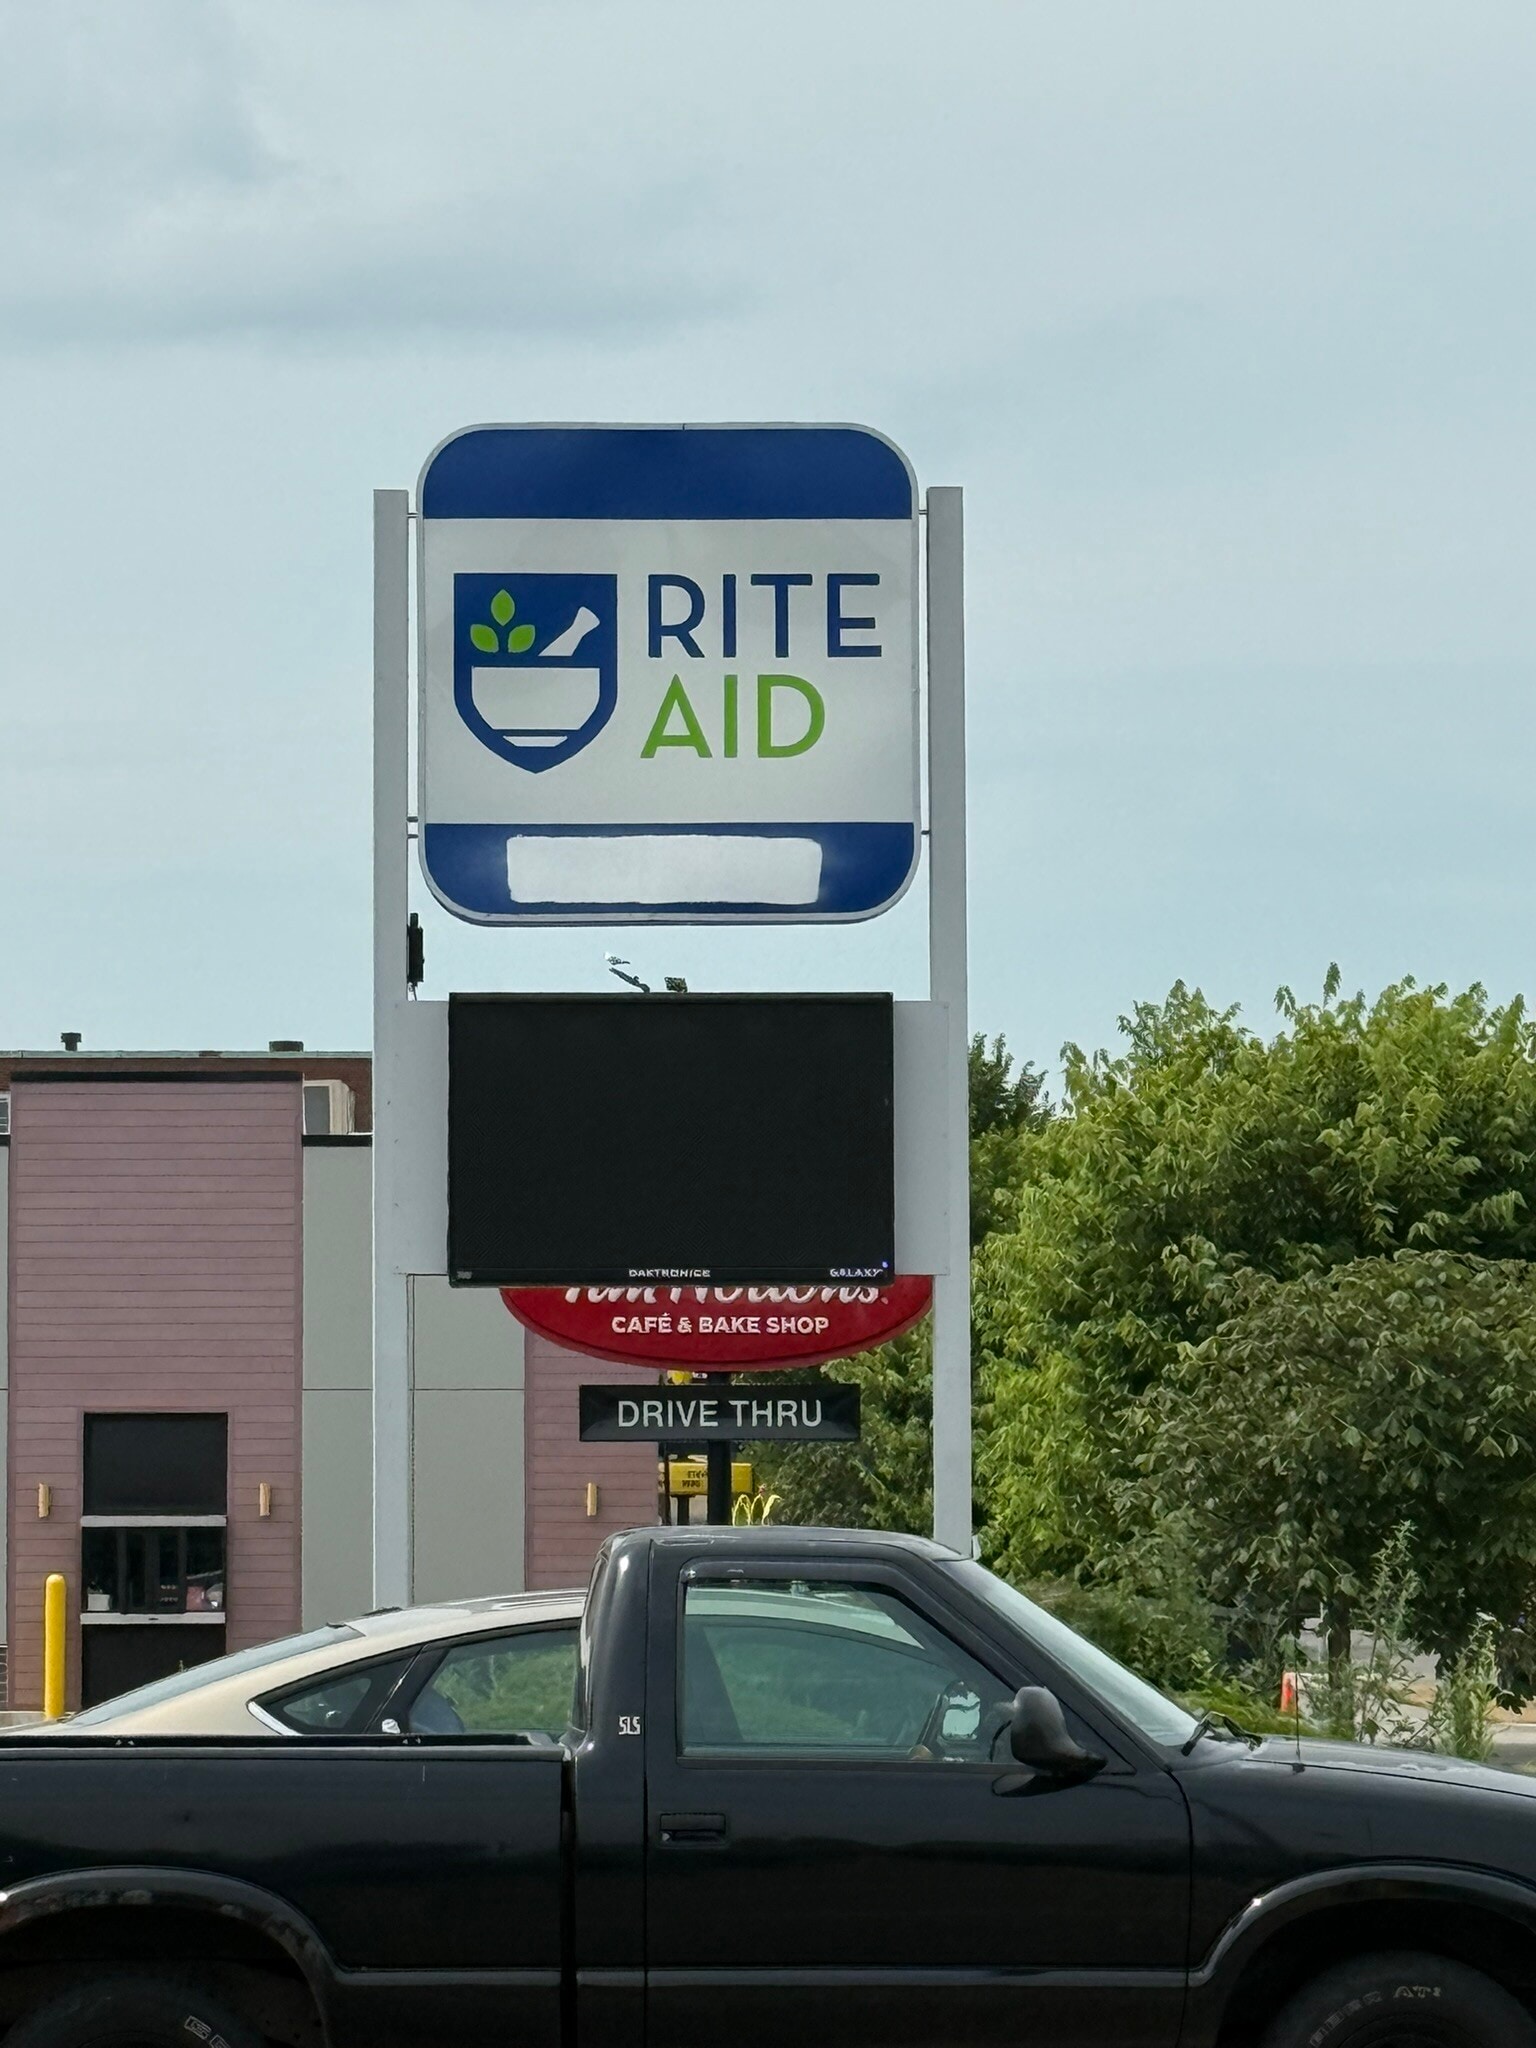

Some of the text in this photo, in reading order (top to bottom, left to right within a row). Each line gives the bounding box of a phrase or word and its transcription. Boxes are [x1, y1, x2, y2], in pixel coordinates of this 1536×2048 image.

[648, 573, 882, 658] RITE
[640, 673, 825, 758] AID
[611, 1312, 829, 1333] CAFÉ & BAKE SHOP
[618, 1400, 822, 1427] DRIVE THRU
